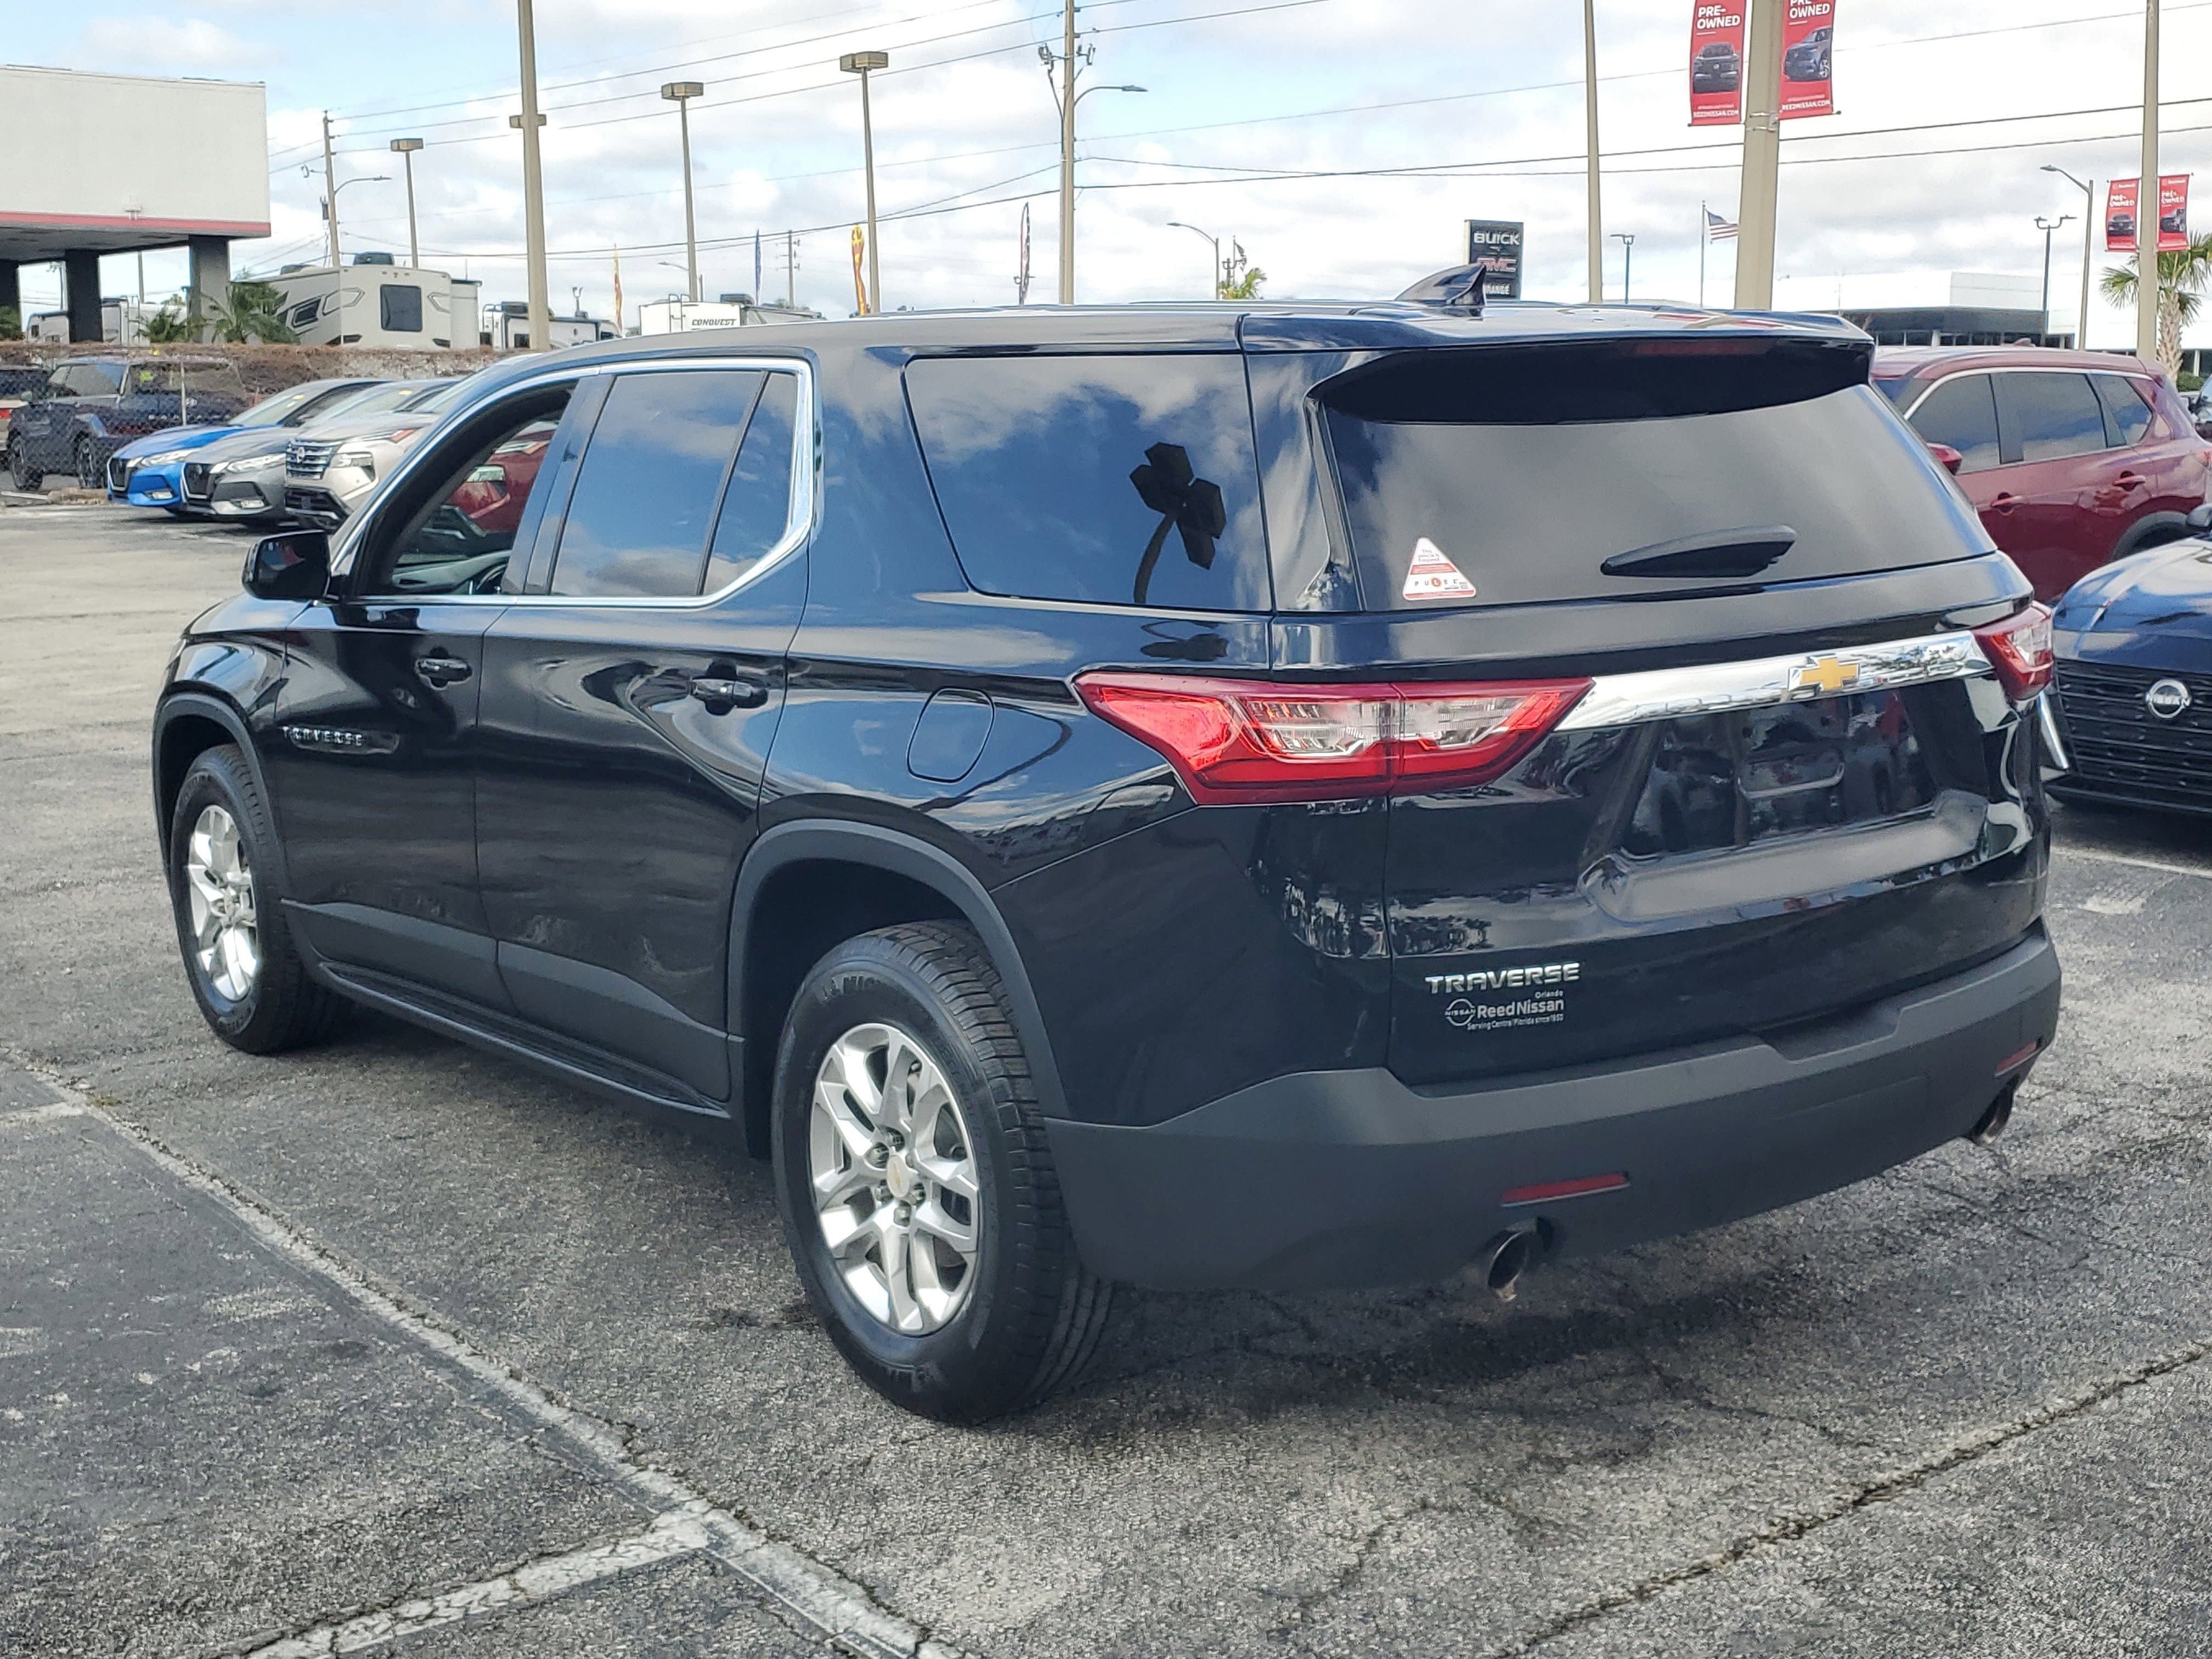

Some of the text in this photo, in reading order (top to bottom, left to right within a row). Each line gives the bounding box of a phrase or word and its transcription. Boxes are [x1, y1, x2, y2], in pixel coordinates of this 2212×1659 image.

[1697, 5, 1726, 18] PRE-
[1790, 3, 1830, 19] OWNED
[1696, 15, 1741, 29] OWNED
[1474, 233, 1519, 245] BUICK
[282, 725, 363, 747] TRAVERSE
[1425, 962, 1580, 994] TRAVERSE
[1535, 989, 1564, 998] Orlando
